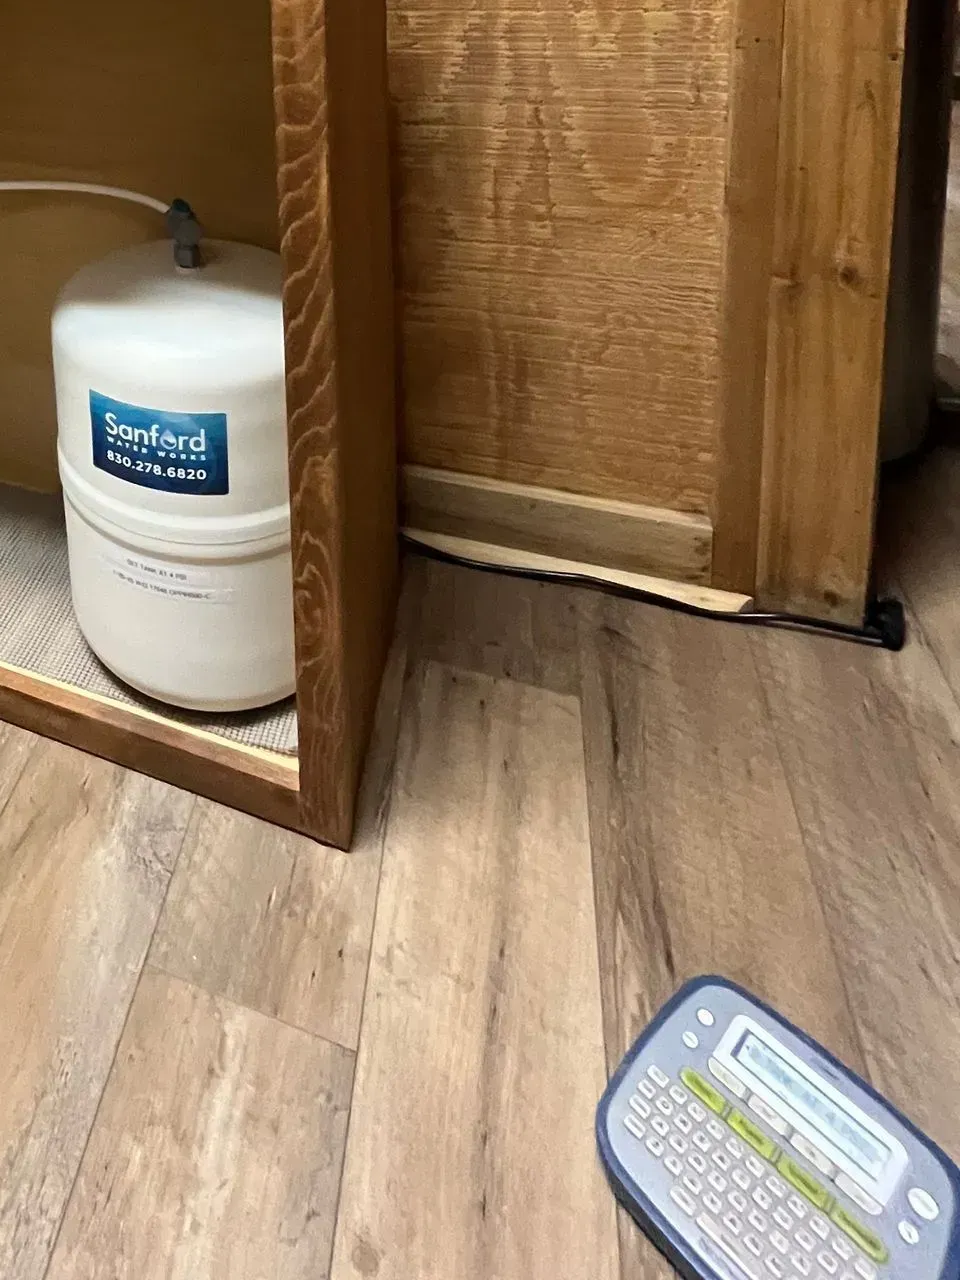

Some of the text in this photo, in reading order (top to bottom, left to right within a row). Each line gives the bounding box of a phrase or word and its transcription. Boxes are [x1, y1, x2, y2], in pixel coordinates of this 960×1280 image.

[105, 412, 206, 452] Sanford
[106, 435, 207, 461] WATER WORKS
[106, 449, 207, 480] 830.278.6820
